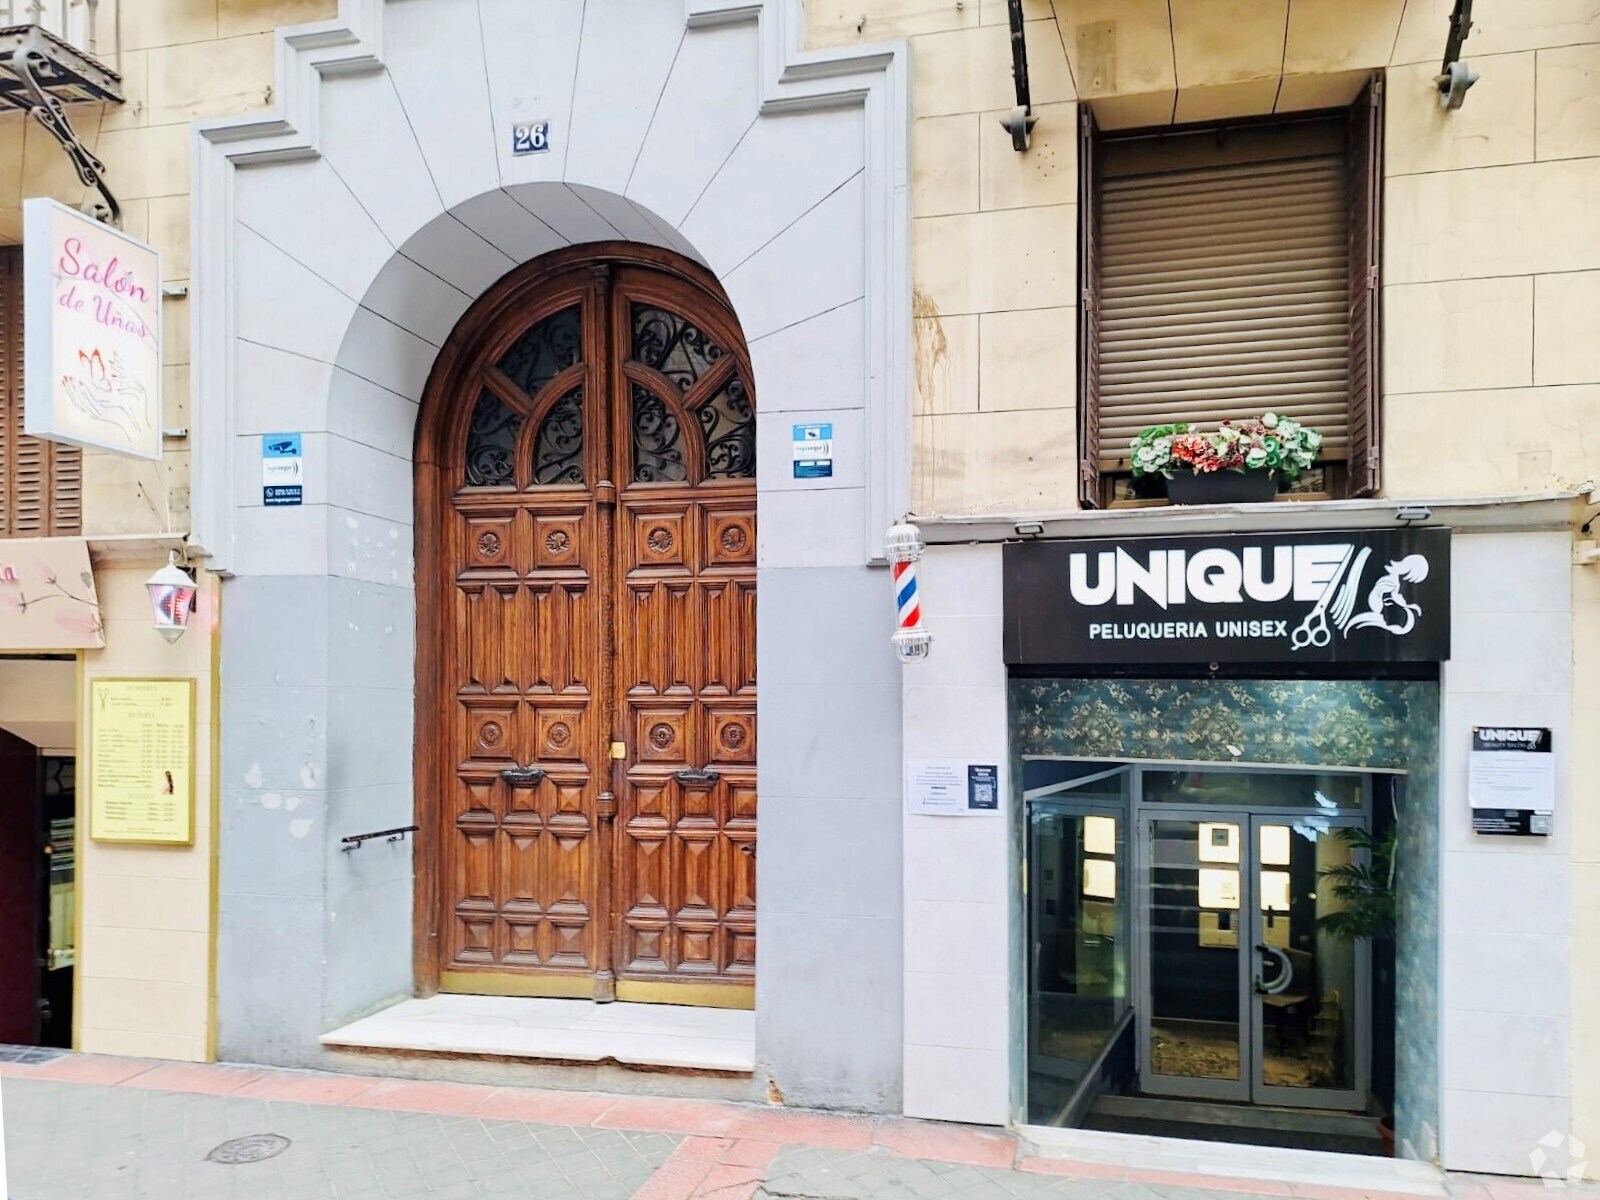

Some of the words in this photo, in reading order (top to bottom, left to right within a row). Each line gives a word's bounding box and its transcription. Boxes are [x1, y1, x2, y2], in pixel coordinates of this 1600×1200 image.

[516, 124, 545, 150] 26
[60, 237, 150, 304] Salón
[60, 285, 84, 312] de
[93, 296, 149, 338] Uñas
[1070, 543, 1355, 611] UNIQUE
[1089, 620, 1208, 641] PELUQUERIA
[1215, 619, 1288, 638] UNISEX
[1479, 729, 1542, 743] UNIQUE
